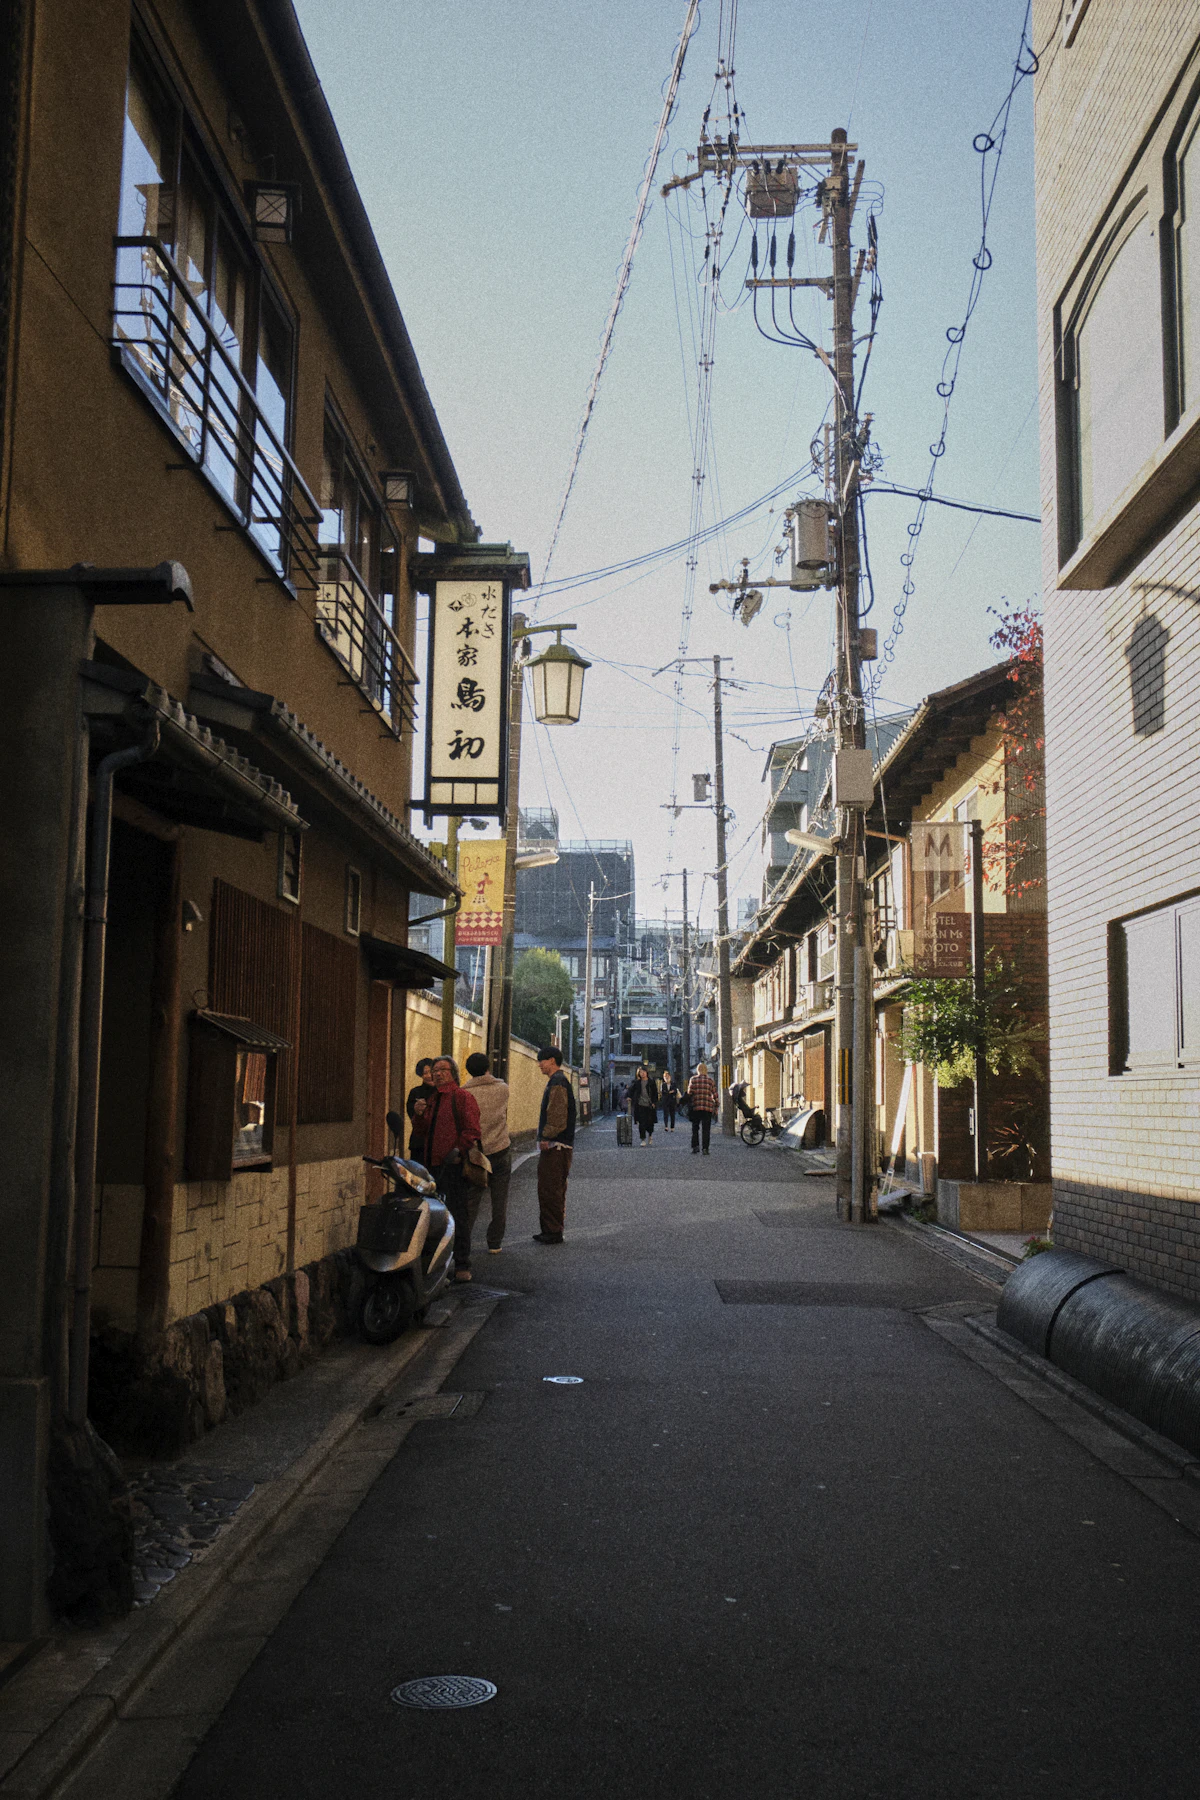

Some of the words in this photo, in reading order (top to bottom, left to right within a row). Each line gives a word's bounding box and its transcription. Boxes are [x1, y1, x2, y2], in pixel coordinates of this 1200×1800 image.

[481, 585, 497, 639] 水だき
[924, 832, 953, 857] M
[923, 916, 956, 925] HOTEL
[916, 930, 947, 939] GRAN
[921, 943, 959, 953] KYOTO
